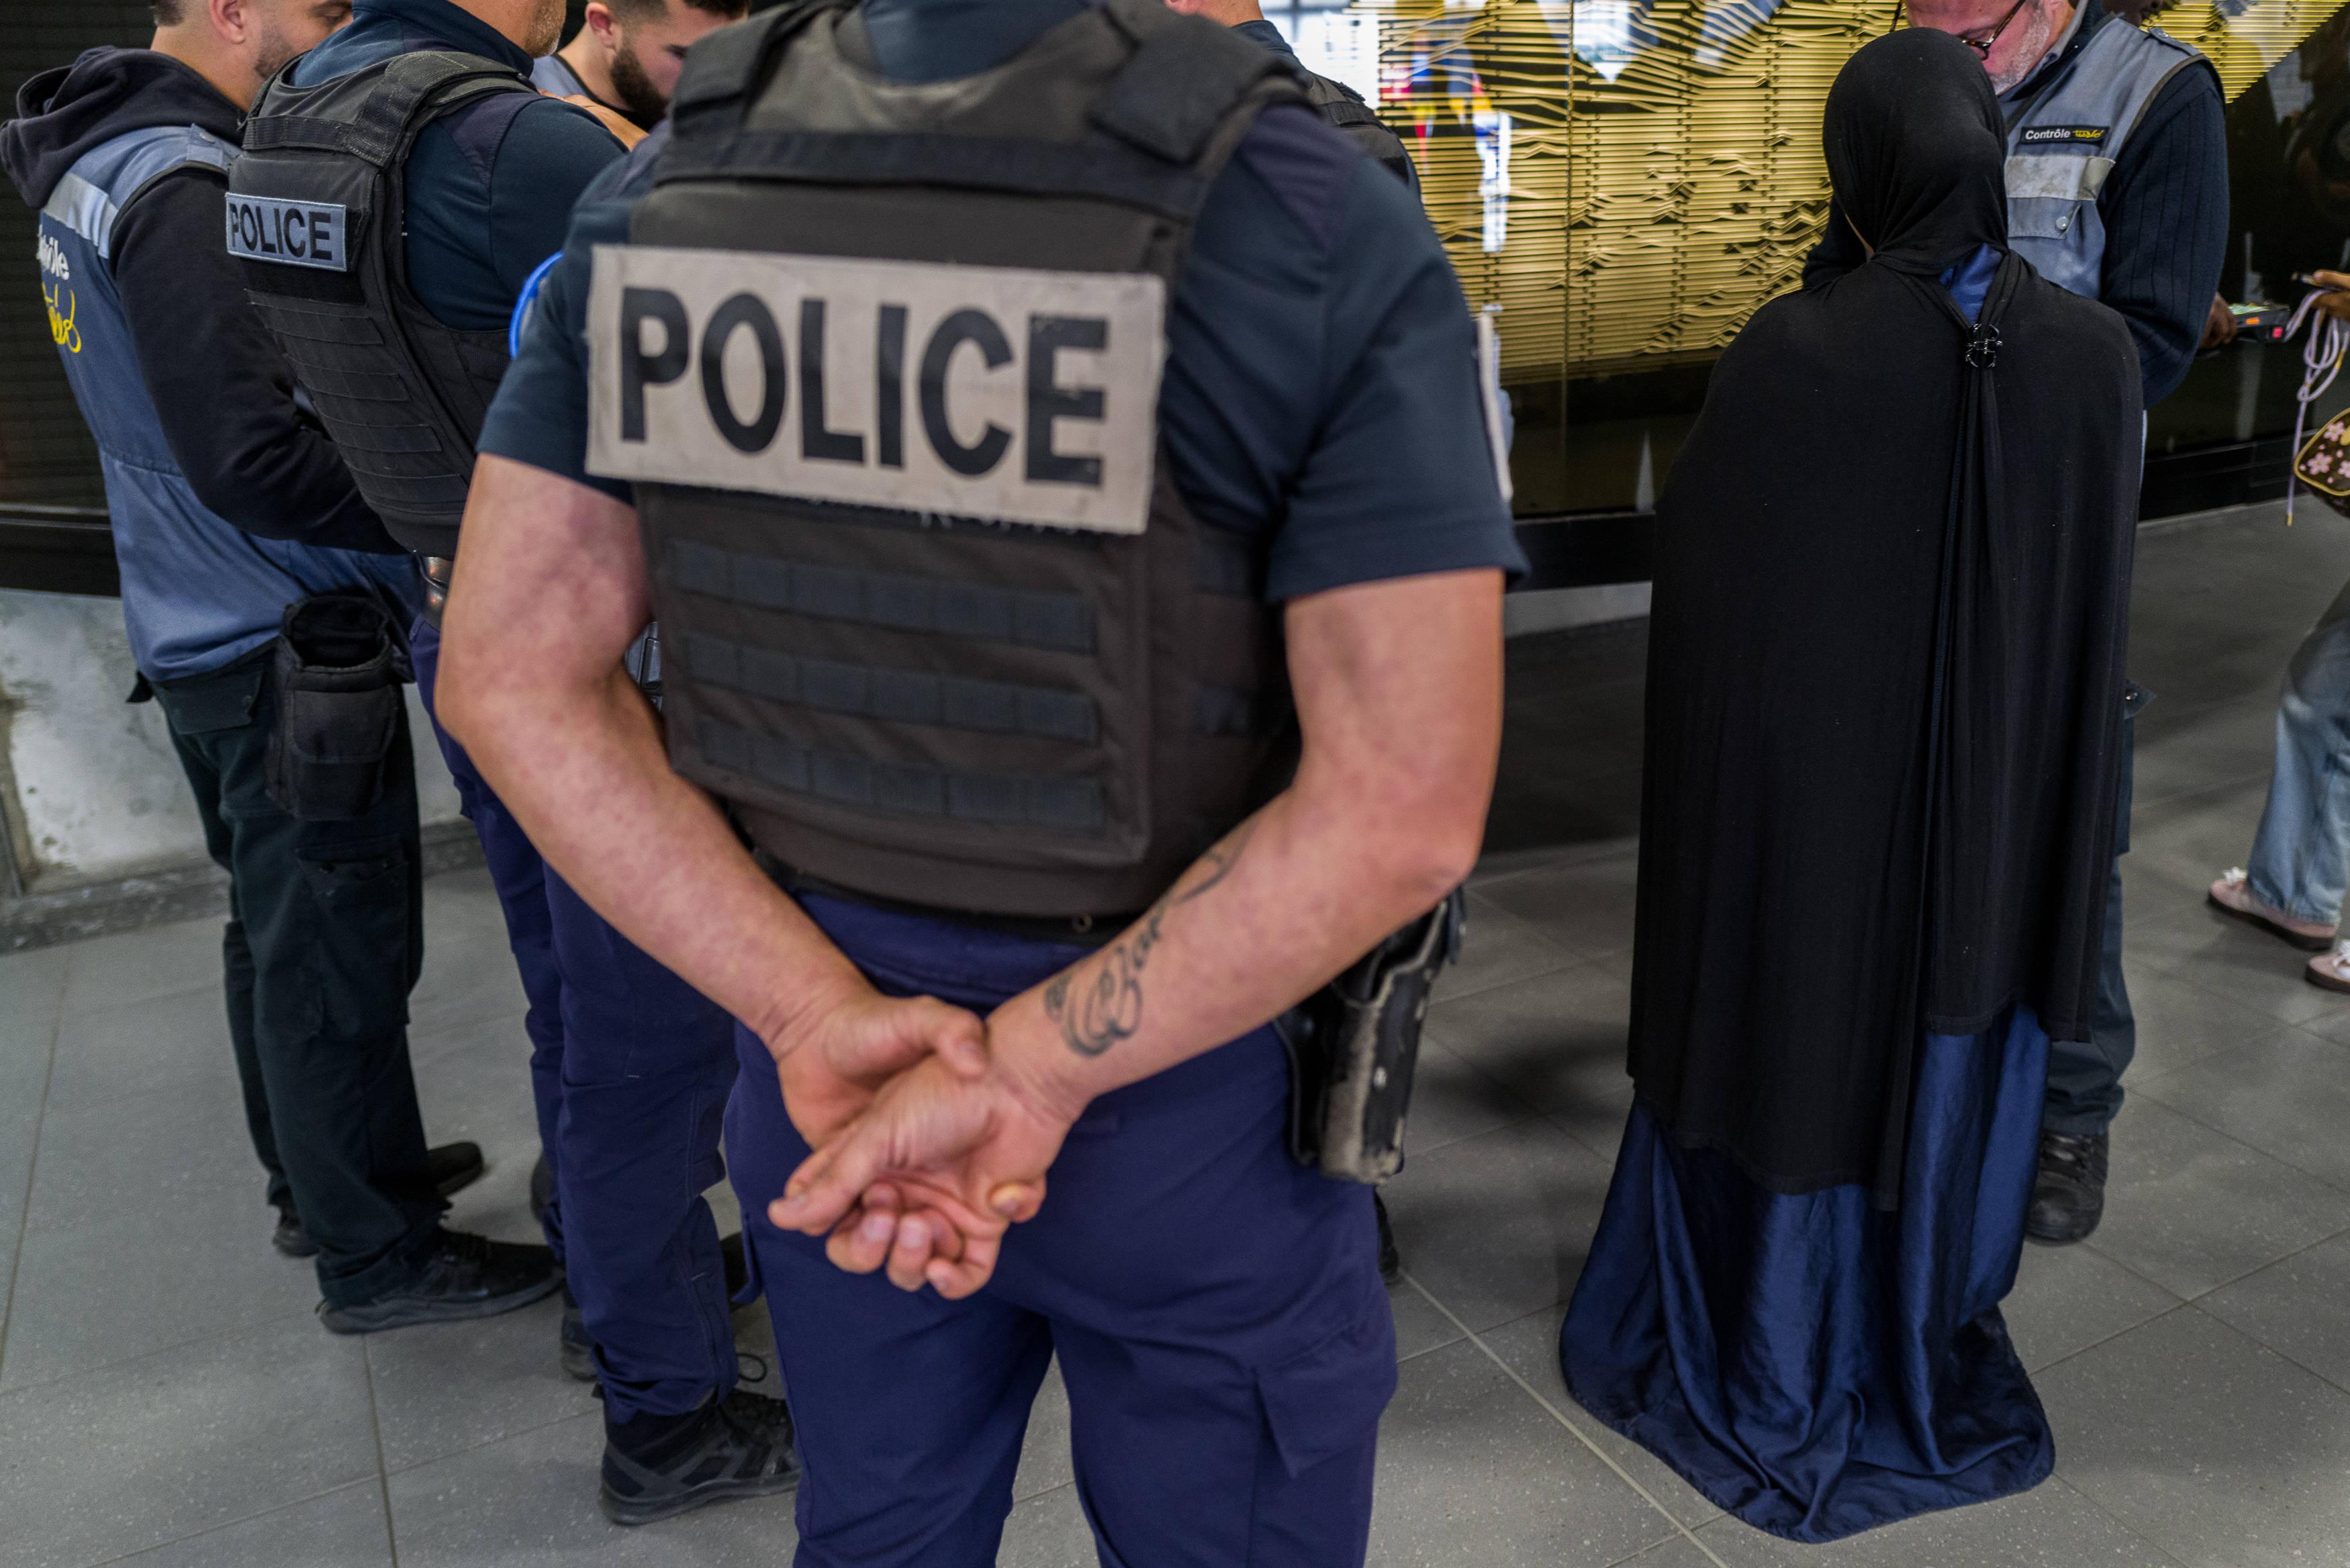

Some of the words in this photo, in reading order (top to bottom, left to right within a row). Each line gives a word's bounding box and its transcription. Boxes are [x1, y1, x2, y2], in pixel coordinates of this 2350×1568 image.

[2025, 128, 2071, 140] Contrôle
[230, 203, 332, 260] POLICE
[620, 286, 1109, 487] POLICE
